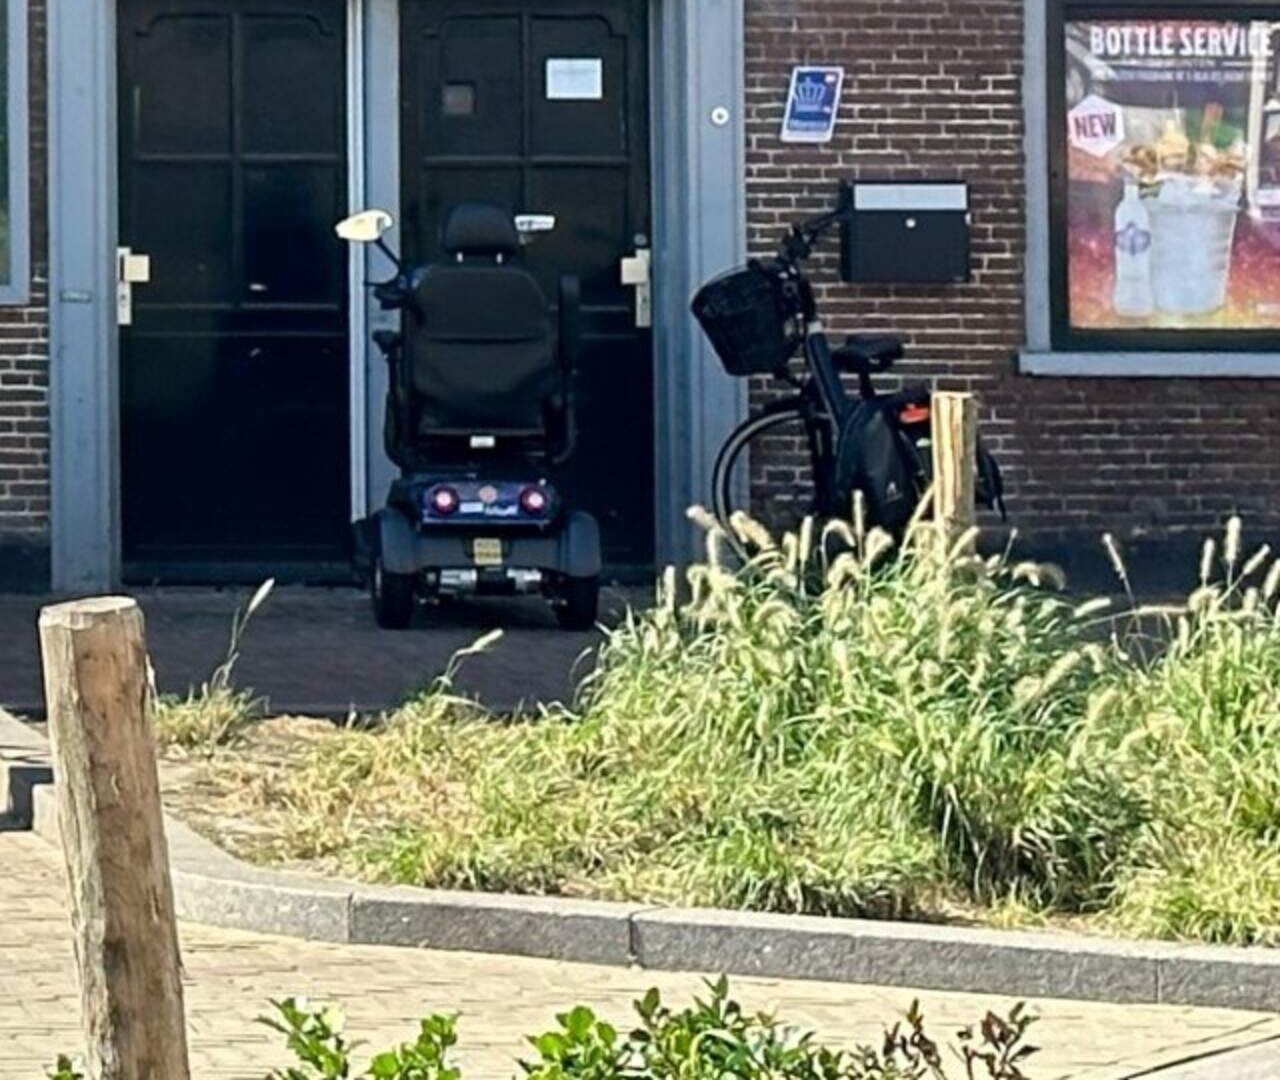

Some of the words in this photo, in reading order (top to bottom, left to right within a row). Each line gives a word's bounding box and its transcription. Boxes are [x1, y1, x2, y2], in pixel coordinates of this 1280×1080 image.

[1090, 25, 1174, 56] BOTTLE
[1179, 22, 1274, 56] SERVICE
[1074, 112, 1116, 137] NEW
